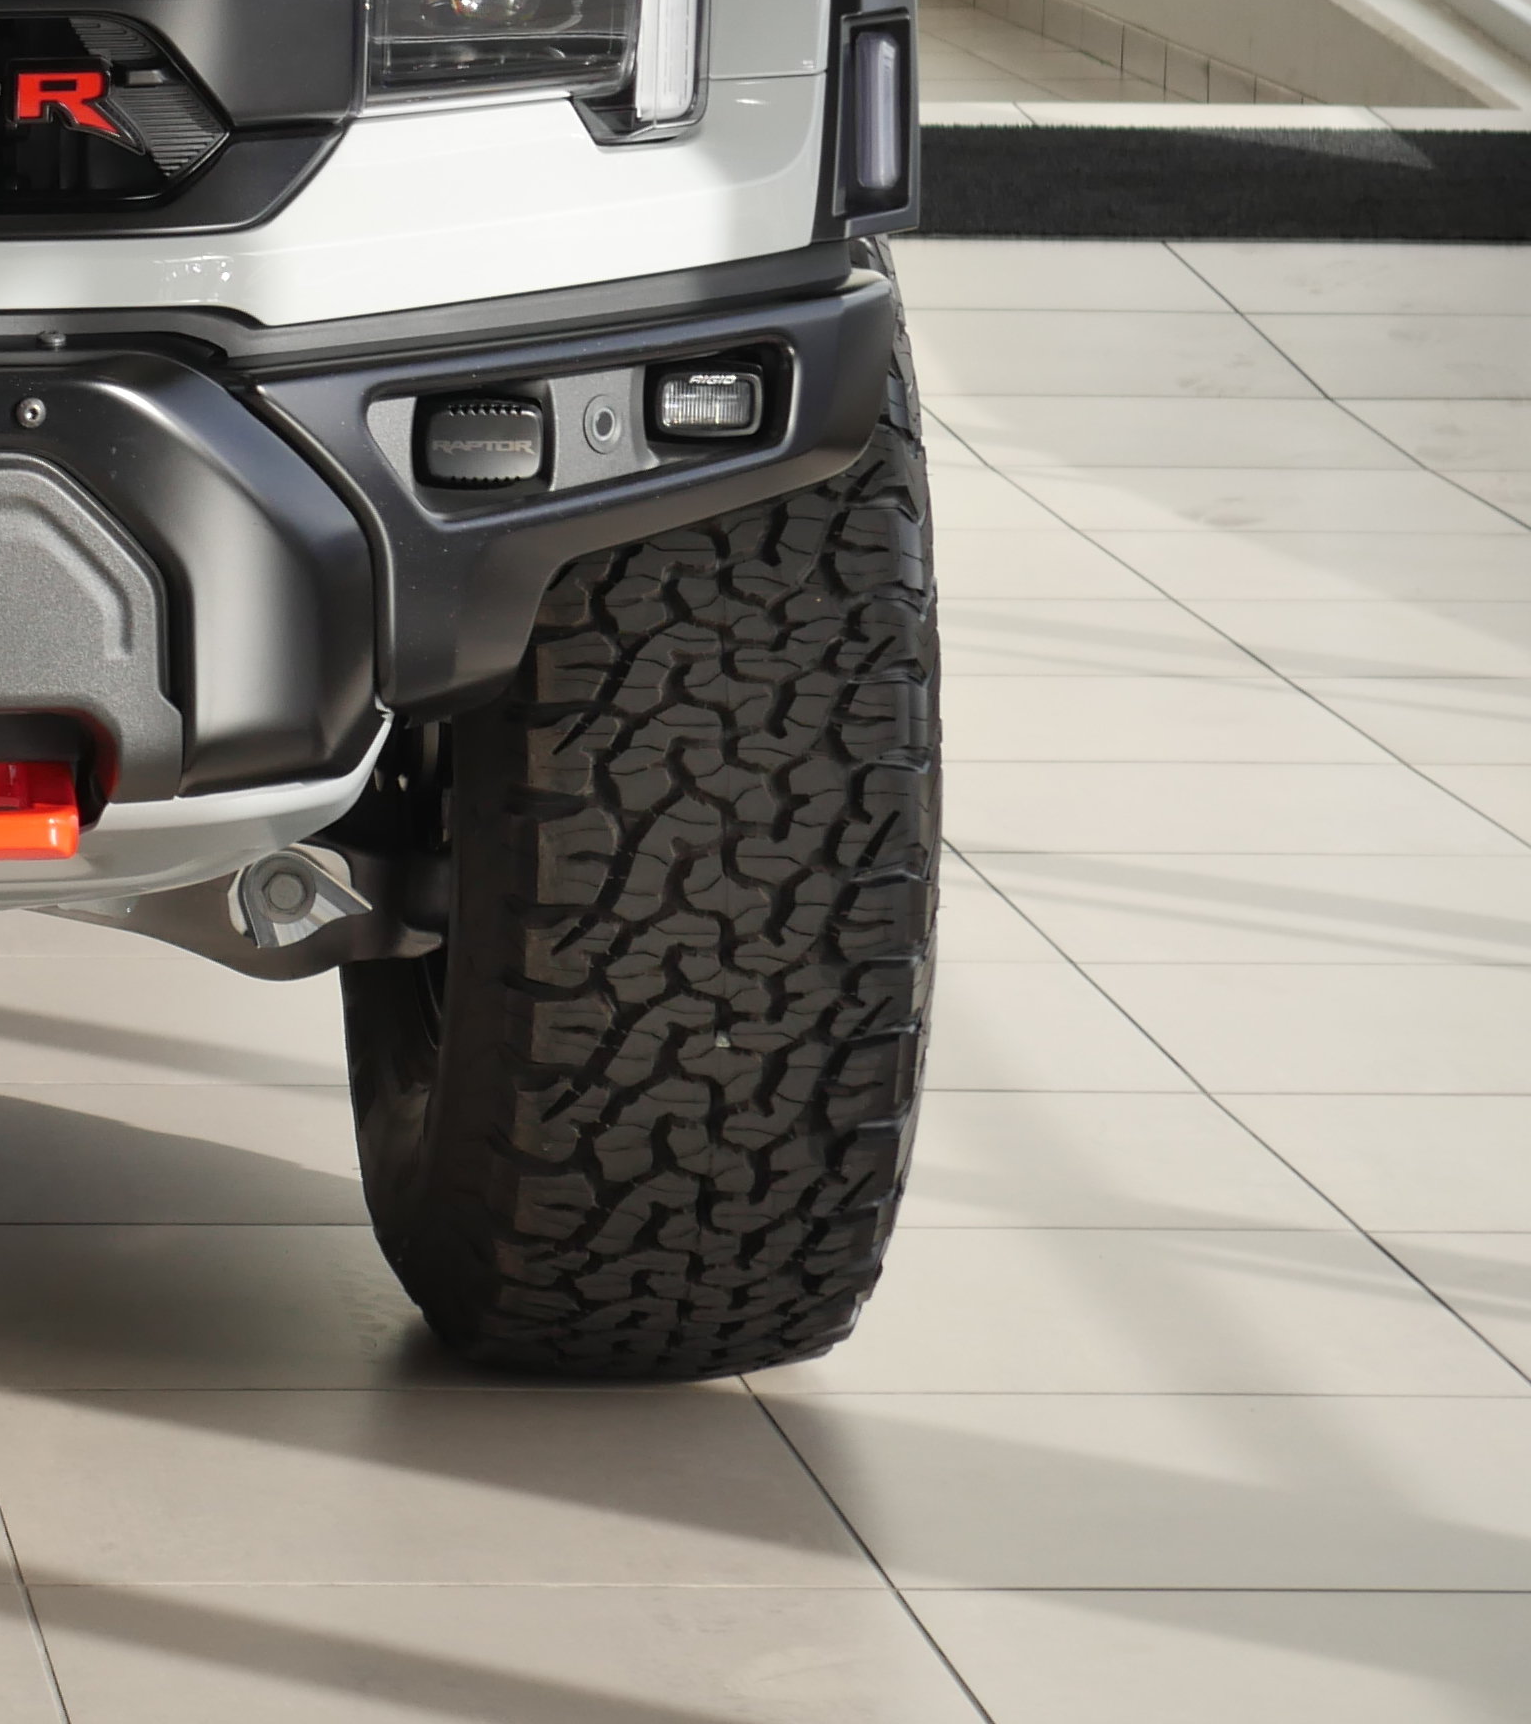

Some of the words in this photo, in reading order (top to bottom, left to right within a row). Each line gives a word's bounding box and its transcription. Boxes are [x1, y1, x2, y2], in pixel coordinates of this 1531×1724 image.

[16, 72, 121, 137] R
[689, 374, 737, 385] RIGID
[433, 440, 536, 455] RAPTOR
